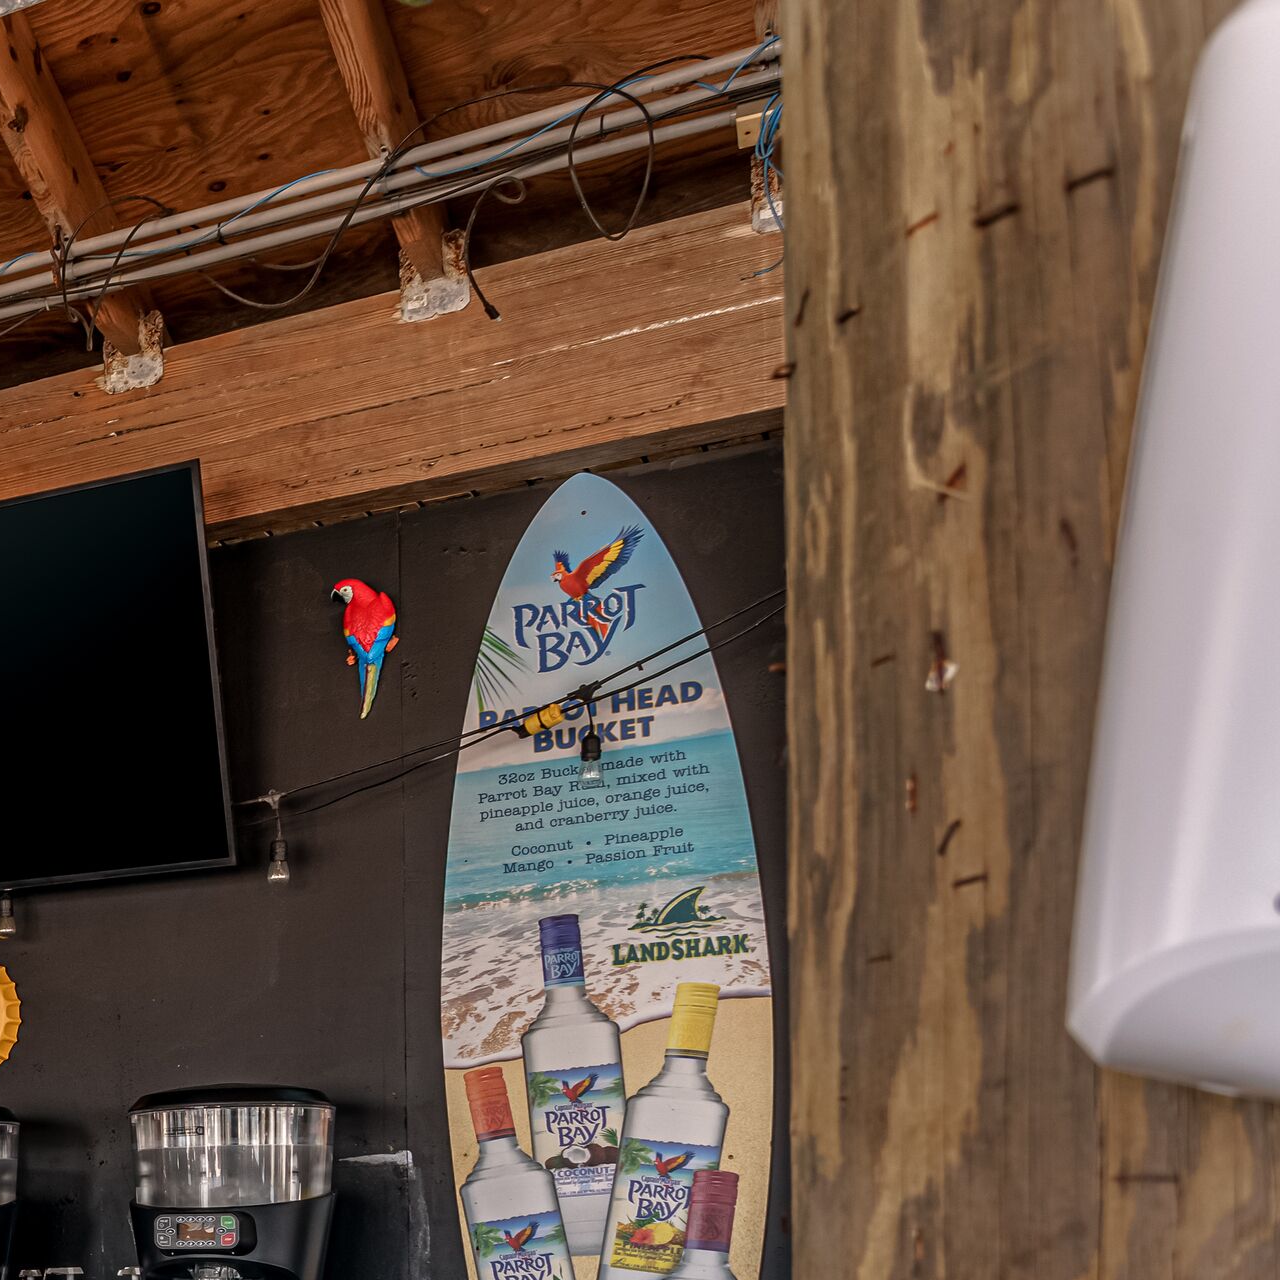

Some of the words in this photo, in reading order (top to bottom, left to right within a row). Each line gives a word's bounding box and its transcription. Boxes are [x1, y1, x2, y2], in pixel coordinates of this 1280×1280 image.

[512, 583, 647, 649] PARROT
[536, 615, 623, 674] BAY
[479, 692, 599, 731] PAOT
[611, 680, 704, 714] HEAD
[533, 716, 655, 753] BUCKET
[498, 772, 536, 786] 32oz
[541, 763, 590, 782] Buck
[601, 756, 644, 772] made
[649, 749, 687, 765] with
[477, 788, 529, 805] Parrot
[533, 785, 563, 798] Bay
[616, 769, 667, 787] mixed
[672, 763, 711, 778] with
[479, 801, 554, 823] pineapple
[557, 798, 600, 814] juice,
[605, 789, 661, 806] orange
[664, 783, 710, 799] juice,
[515, 817, 544, 832] and
[549, 808, 630, 829] cranberry
[634, 804, 678, 819] juice.
[511, 839, 574, 857] Coconut
[604, 826, 685, 846] Pineapple
[502, 859, 555, 875] Mango
[585, 847, 647, 865] Passion
[652, 841, 695, 858] Fruit
[544, 950, 581, 970] PARROT
[612, 934, 749, 966] LANDSHARK
[551, 962, 580, 979] BAY
[545, 1106, 611, 1134] PARROT
[557, 1124, 600, 1147] BAY
[557, 1166, 610, 1177] COCONUT
[628, 1179, 692, 1210] PARROT
[636, 1197, 684, 1222] BAY
